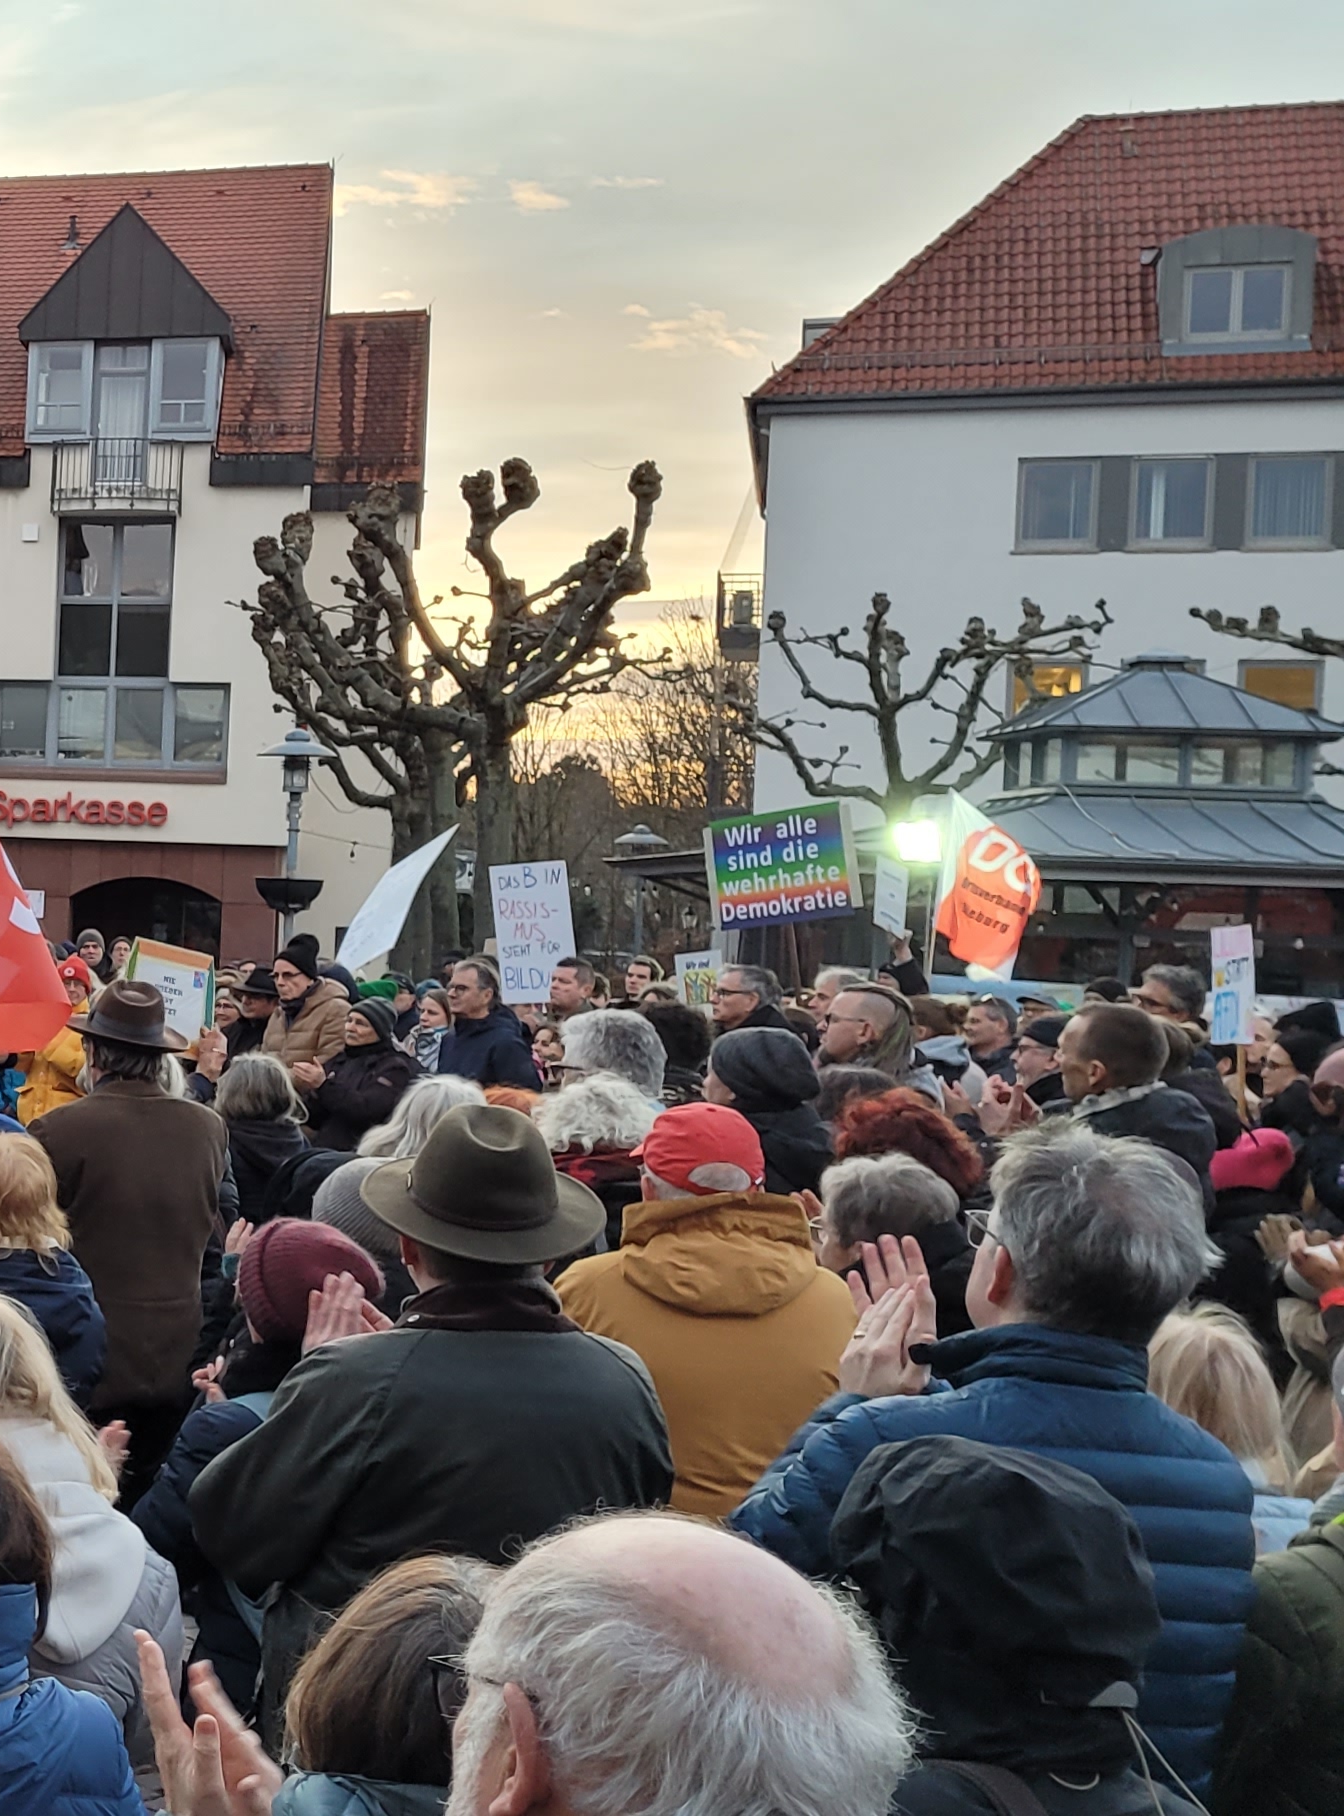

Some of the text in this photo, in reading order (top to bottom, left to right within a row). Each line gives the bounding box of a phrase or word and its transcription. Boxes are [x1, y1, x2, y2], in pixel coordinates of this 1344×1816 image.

[724, 814, 817, 847] Wir alle
[727, 839, 819, 872] sind die
[498, 866, 561, 890] DAS B IN
[722, 864, 840, 897] wehrhafte
[498, 898, 559, 920] RASSIS-
[721, 887, 847, 923] Demokratie
[514, 922, 546, 942] MUS
[155, 984, 183, 996] IEDER
[504, 966, 551, 990] BILDU
